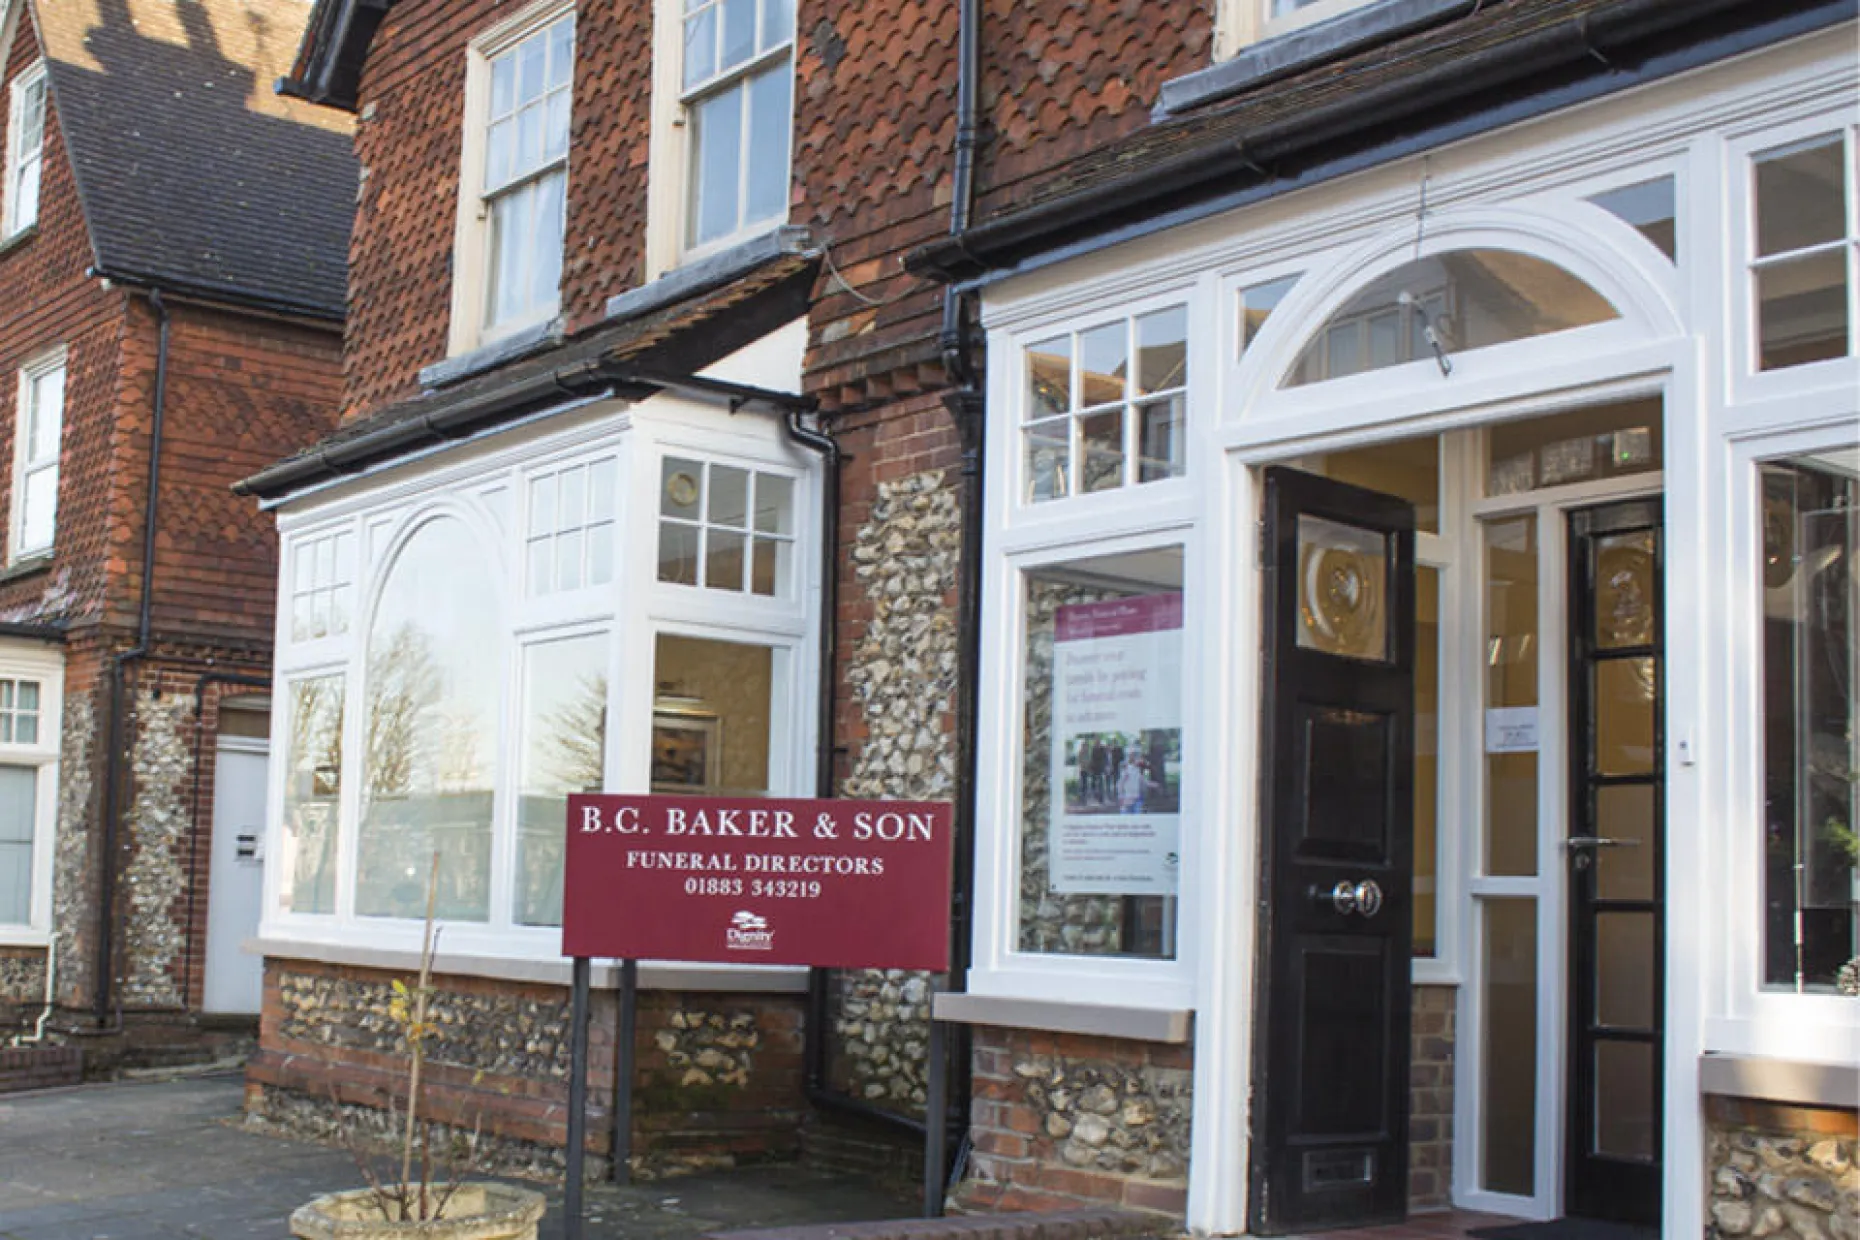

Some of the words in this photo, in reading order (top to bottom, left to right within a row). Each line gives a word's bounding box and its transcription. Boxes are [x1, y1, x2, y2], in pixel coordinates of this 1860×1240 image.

[581, 806, 650, 834] B.C.
[666, 808, 798, 838] BAKER
[812, 812, 839, 840] &
[853, 812, 935, 842] SON
[627, 851, 737, 871] FUNERAL
[744, 854, 885, 875] DIRECTORS
[684, 877, 743, 896] 01883
[751, 878, 822, 898] 343219
